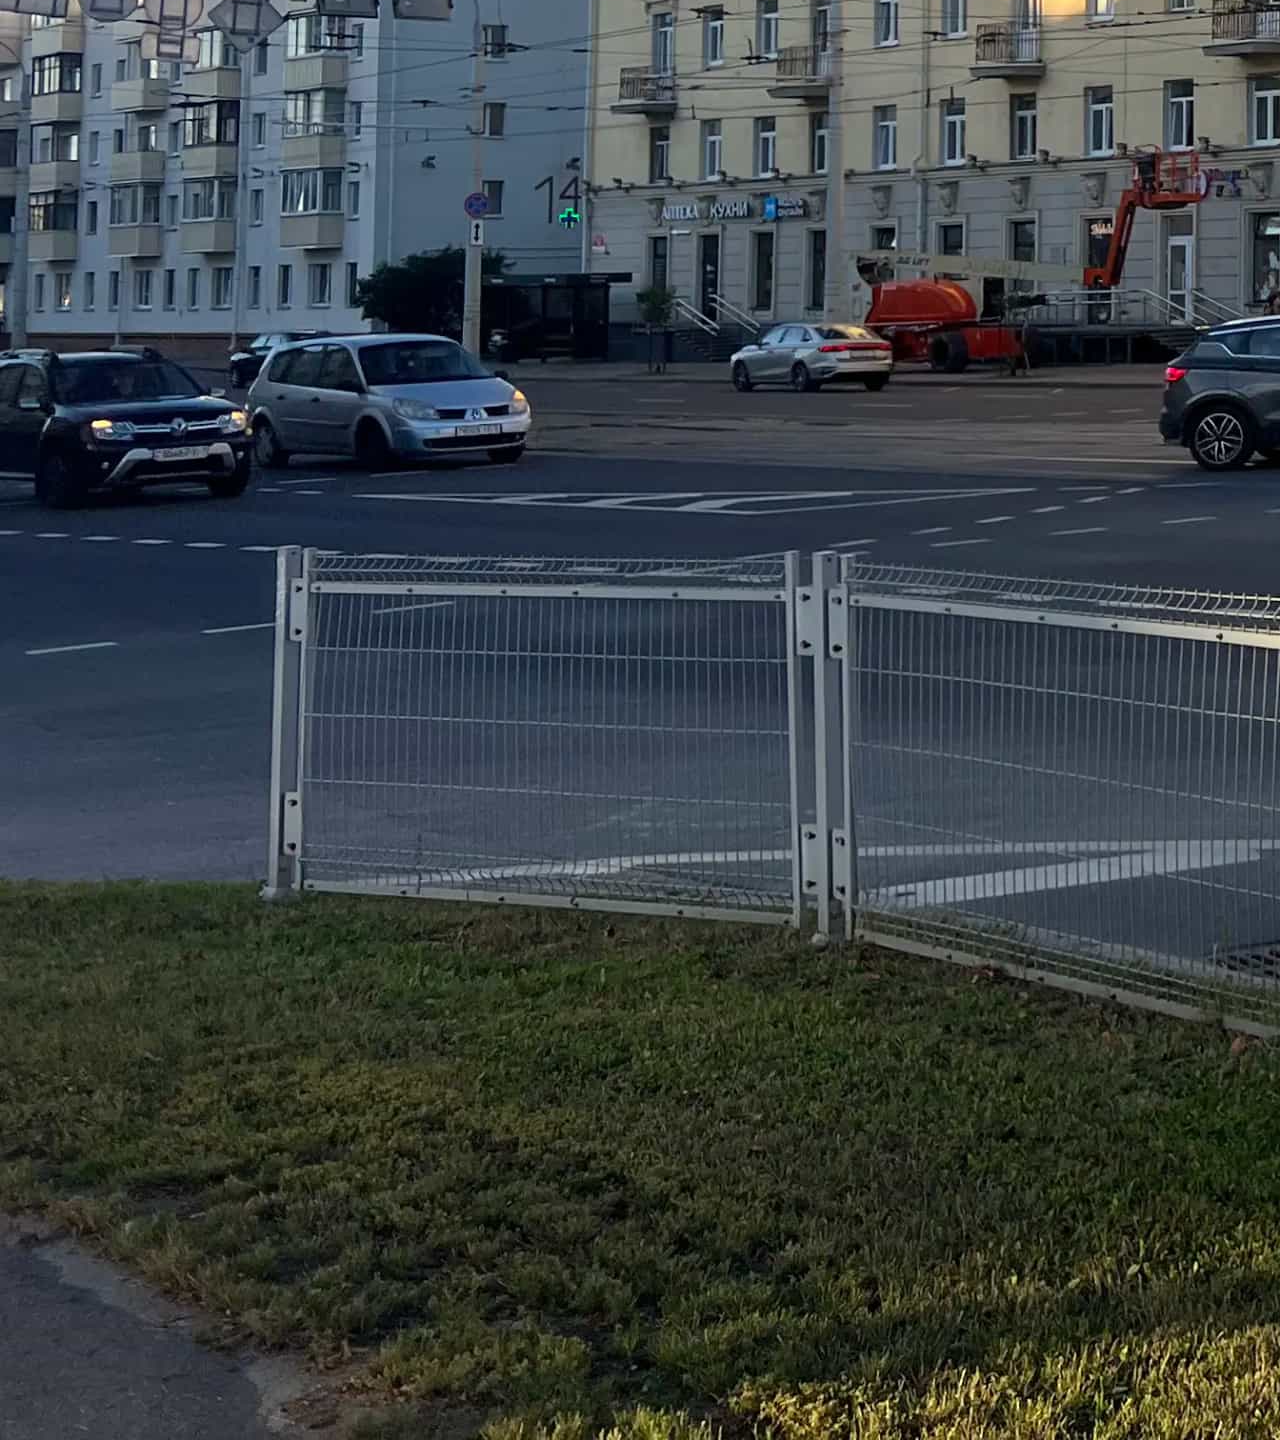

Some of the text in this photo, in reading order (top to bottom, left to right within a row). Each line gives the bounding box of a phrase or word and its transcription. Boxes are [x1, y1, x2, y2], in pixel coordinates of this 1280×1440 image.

[534, 176, 582, 224] 14
[661, 200, 748, 220] АПТЕКА КУХНИ
